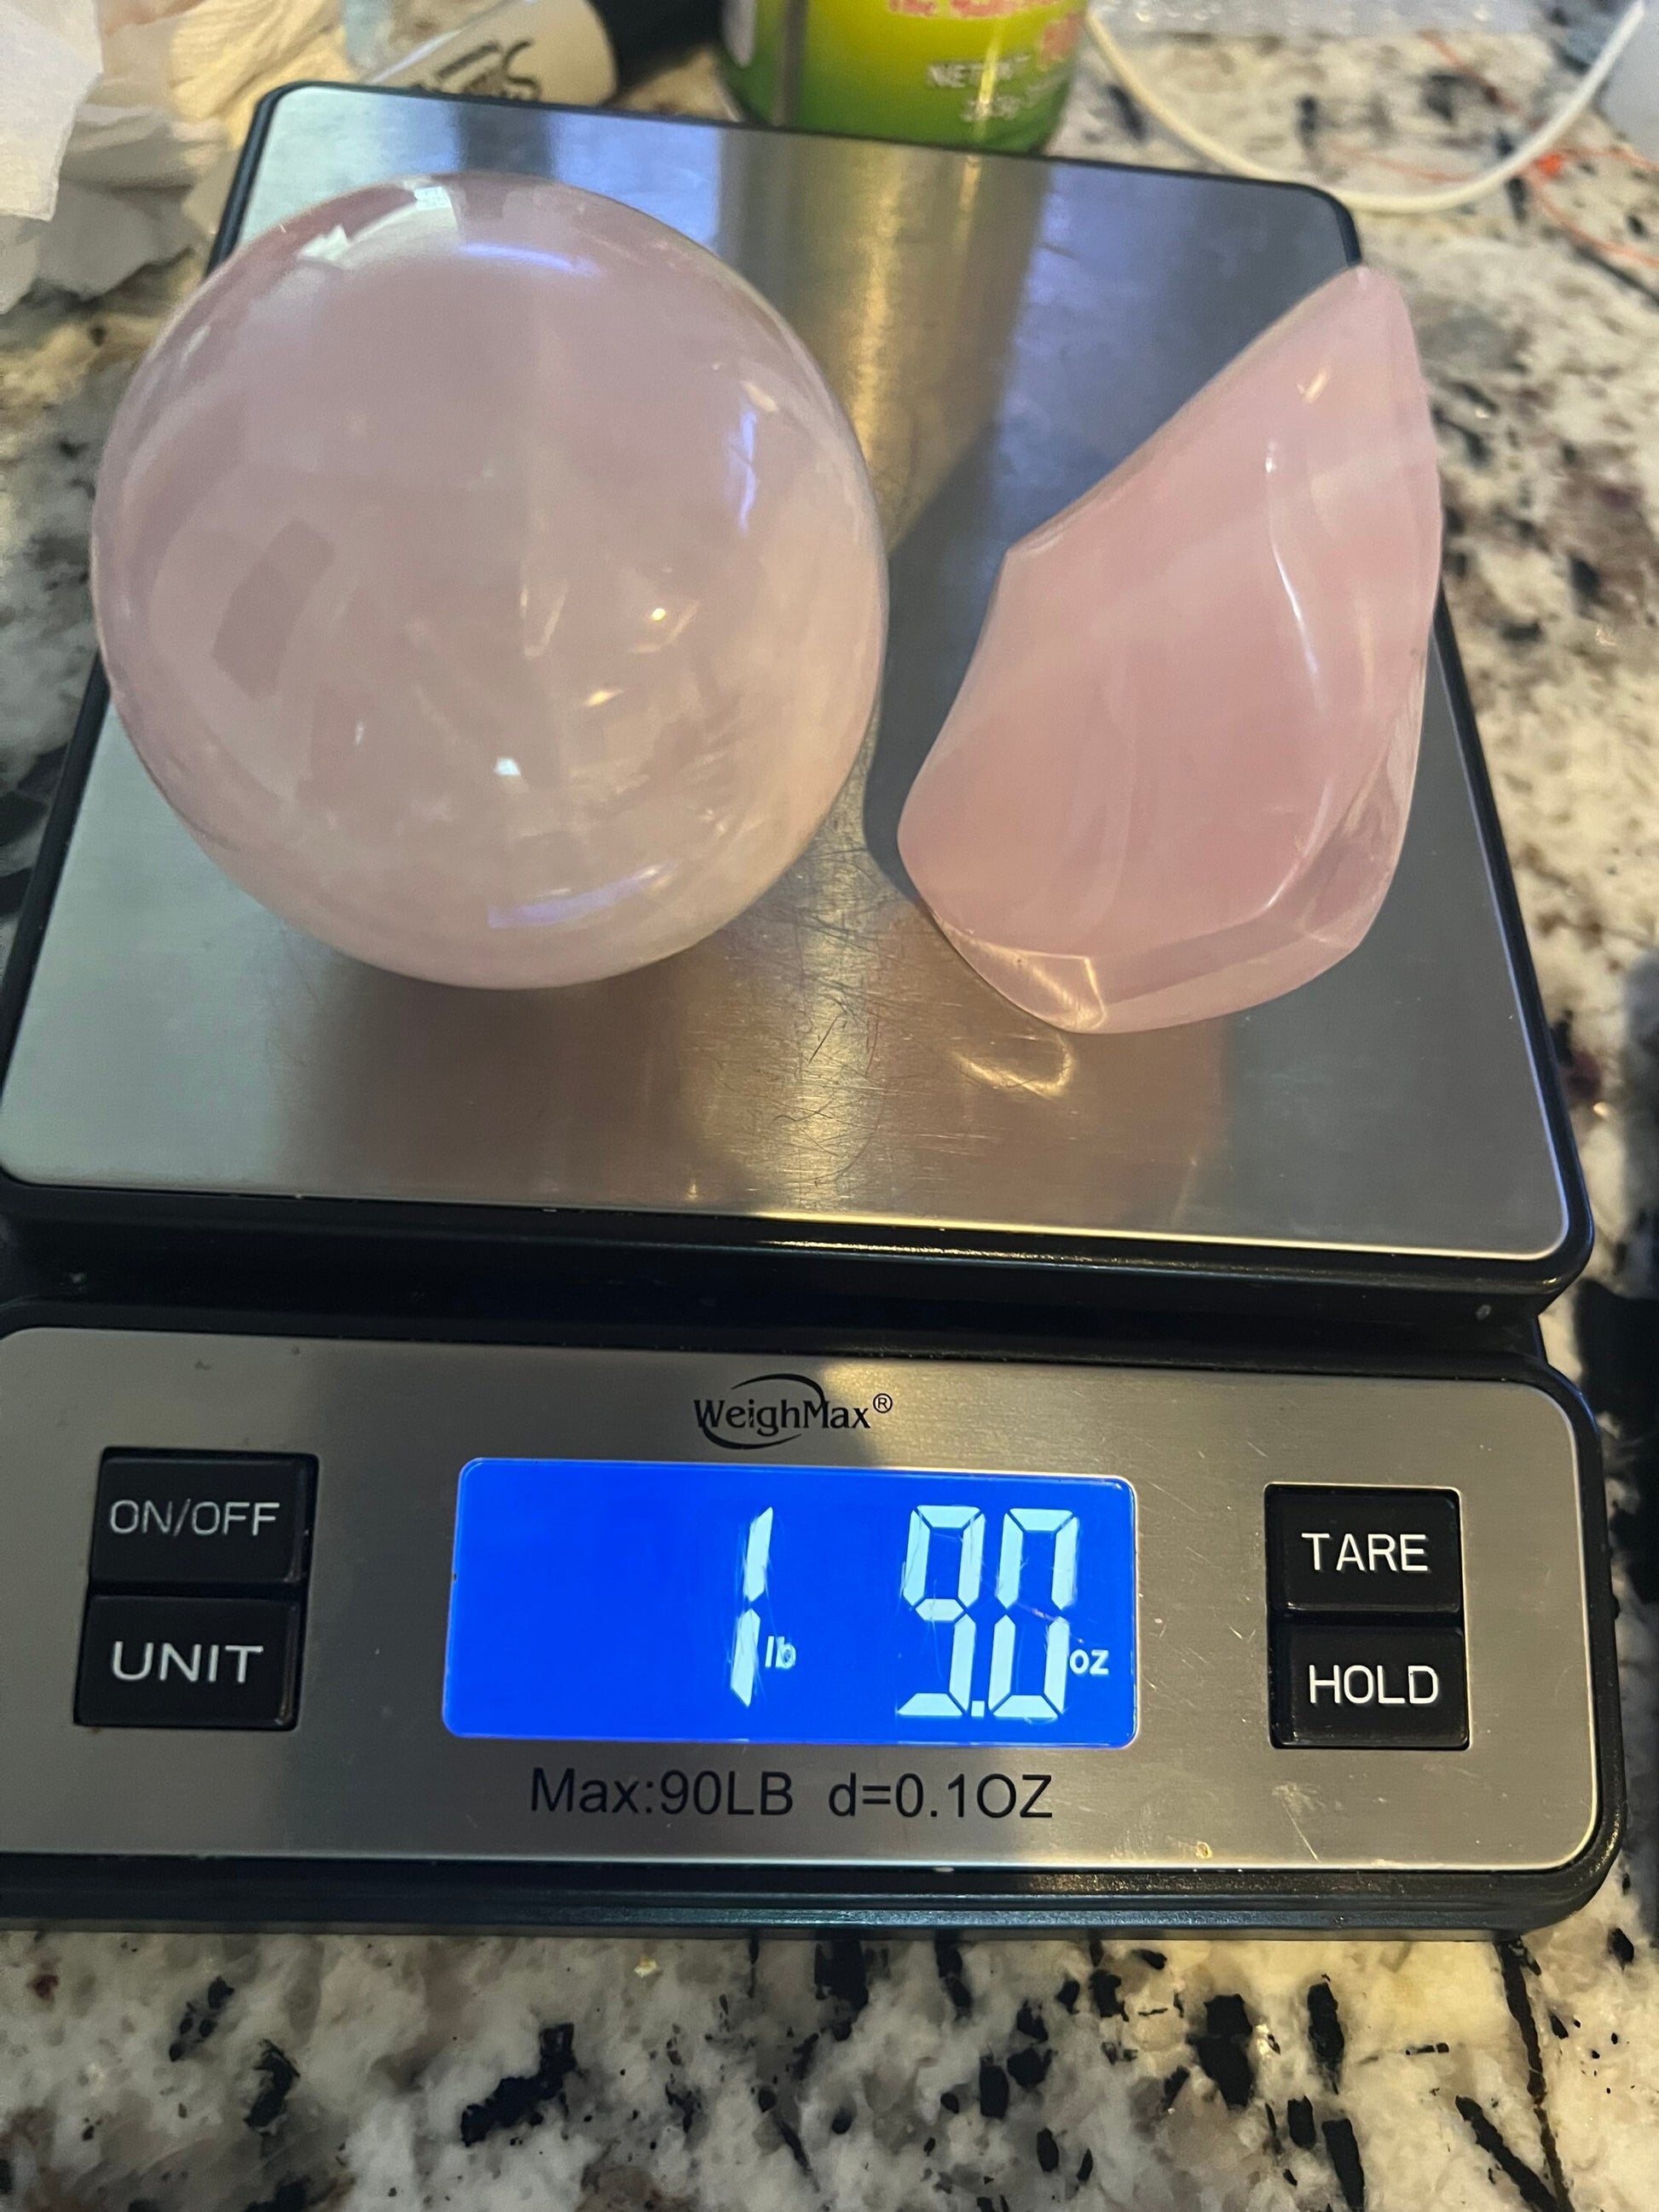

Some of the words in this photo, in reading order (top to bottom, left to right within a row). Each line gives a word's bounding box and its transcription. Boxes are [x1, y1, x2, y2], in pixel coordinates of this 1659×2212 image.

[110, 1499, 280, 1536] ON/OFF
[1301, 1533, 1428, 1571] TARE
[729, 1506, 773, 1707] 1
[765, 1636, 796, 1669] lb
[898, 1505, 1080, 1720] 9.0
[1070, 1651, 1109, 1677] oz
[112, 1641, 264, 1683] UNIT
[1309, 1665, 1438, 1704] HOLD
[530, 1767, 794, 1817] Max:90LB
[828, 1773, 1054, 1819] d=0.1OZ
